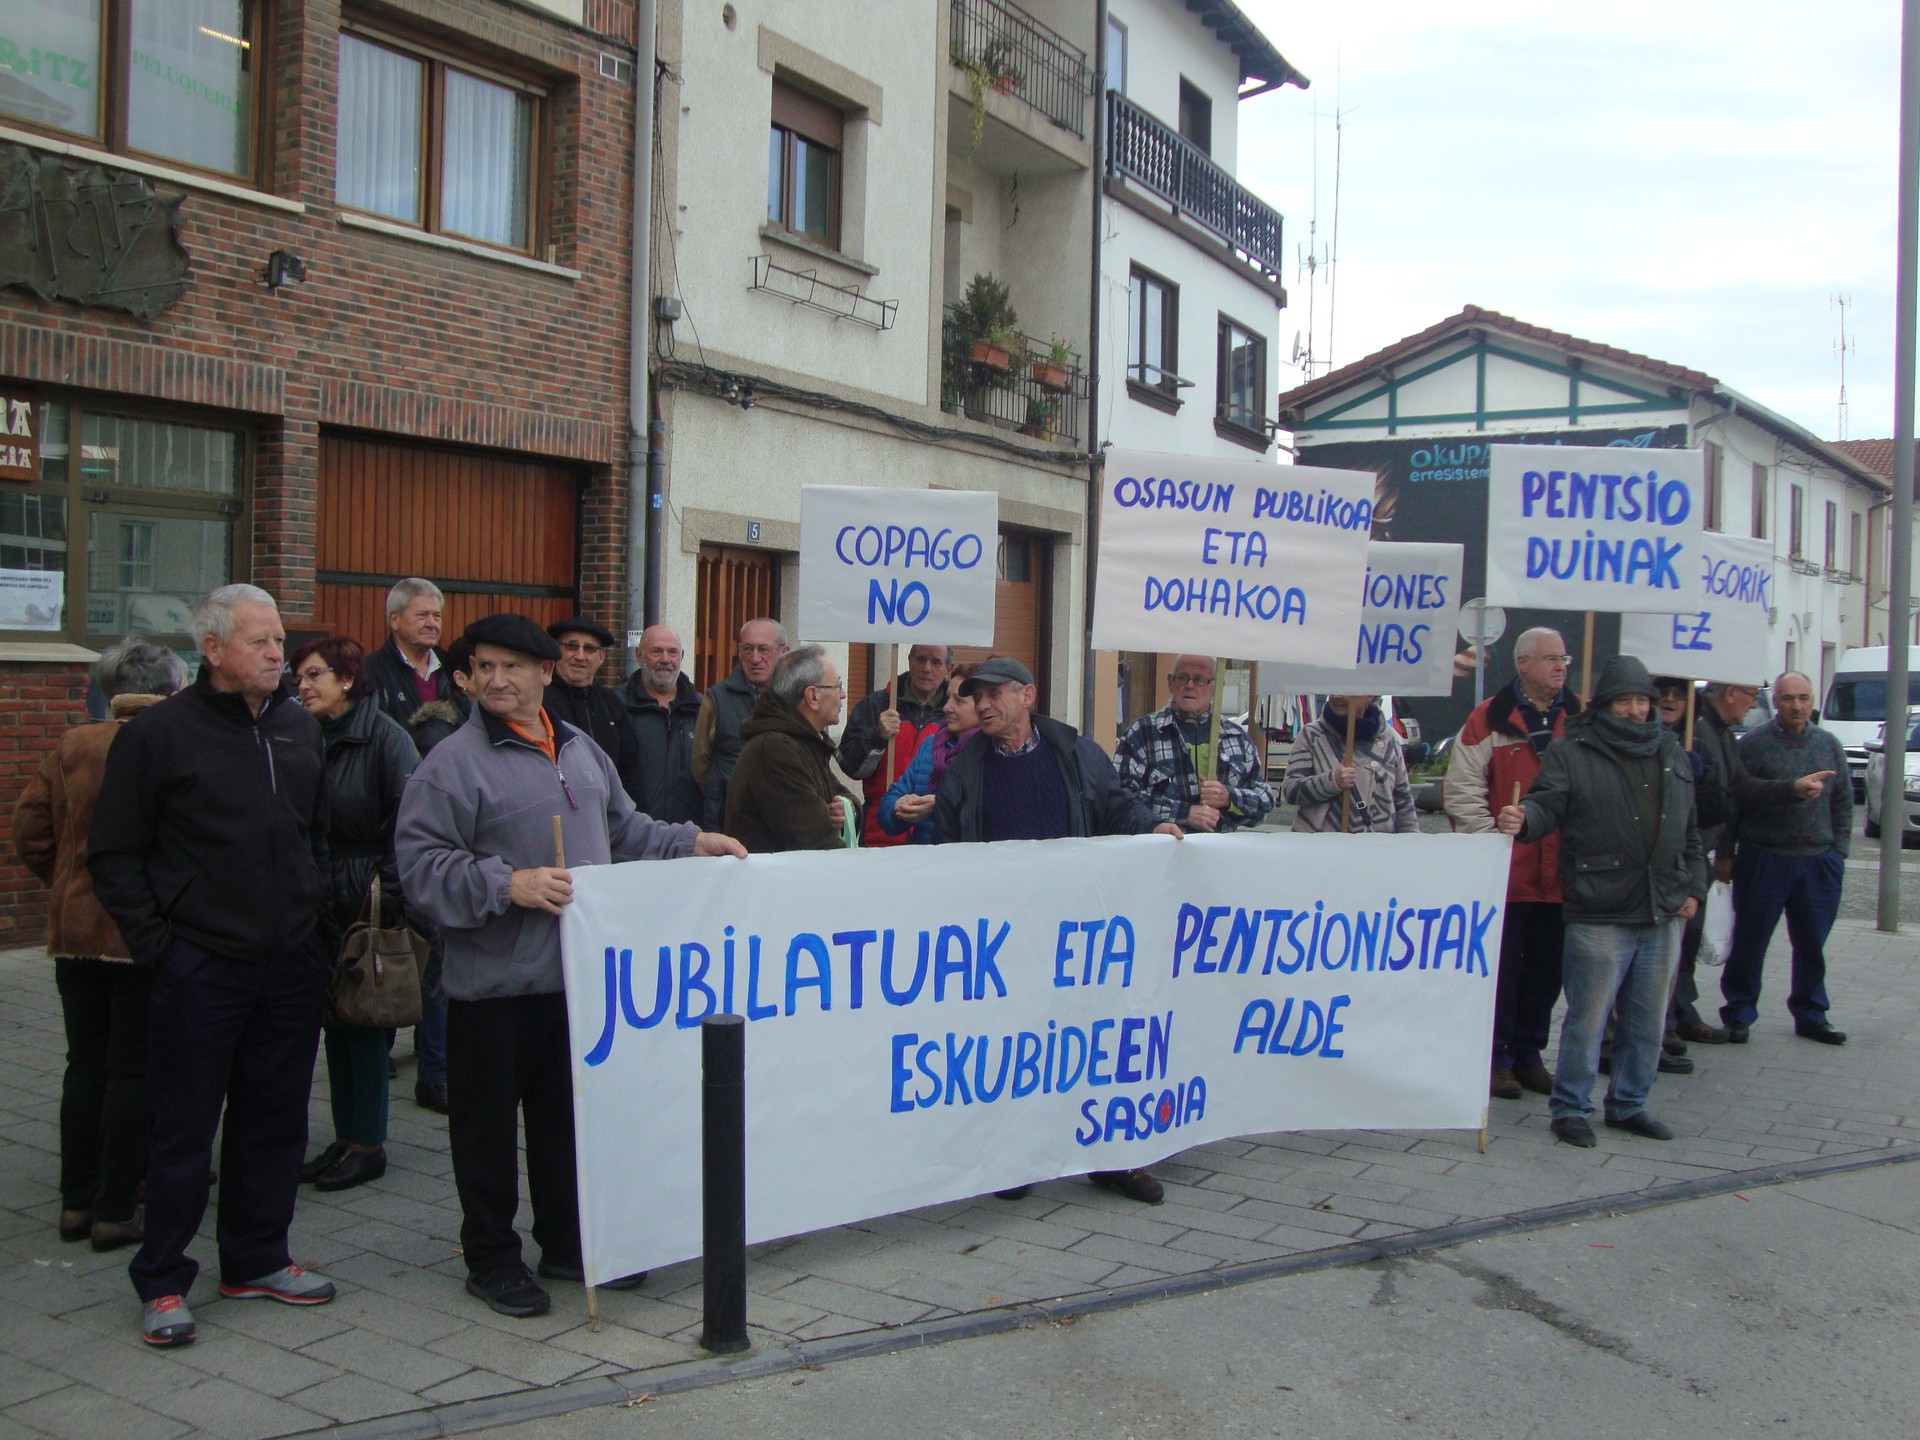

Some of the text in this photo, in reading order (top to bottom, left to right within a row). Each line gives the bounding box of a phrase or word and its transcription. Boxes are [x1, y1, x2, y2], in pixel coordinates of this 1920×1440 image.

[1114, 476, 1234, 513] OSASUN
[751, 524, 758, 539] 5
[835, 524, 984, 572] COPAGO
[1202, 527, 1268, 567] ETA
[867, 577, 932, 628] NO
[1144, 575, 1307, 625] DOHAKOA
[1672, 612, 1713, 652] EZ
[1051, 914, 1137, 990] ETA
[1231, 993, 1352, 1060] ALDE
[1075, 1074, 1209, 1148] SASOIA
